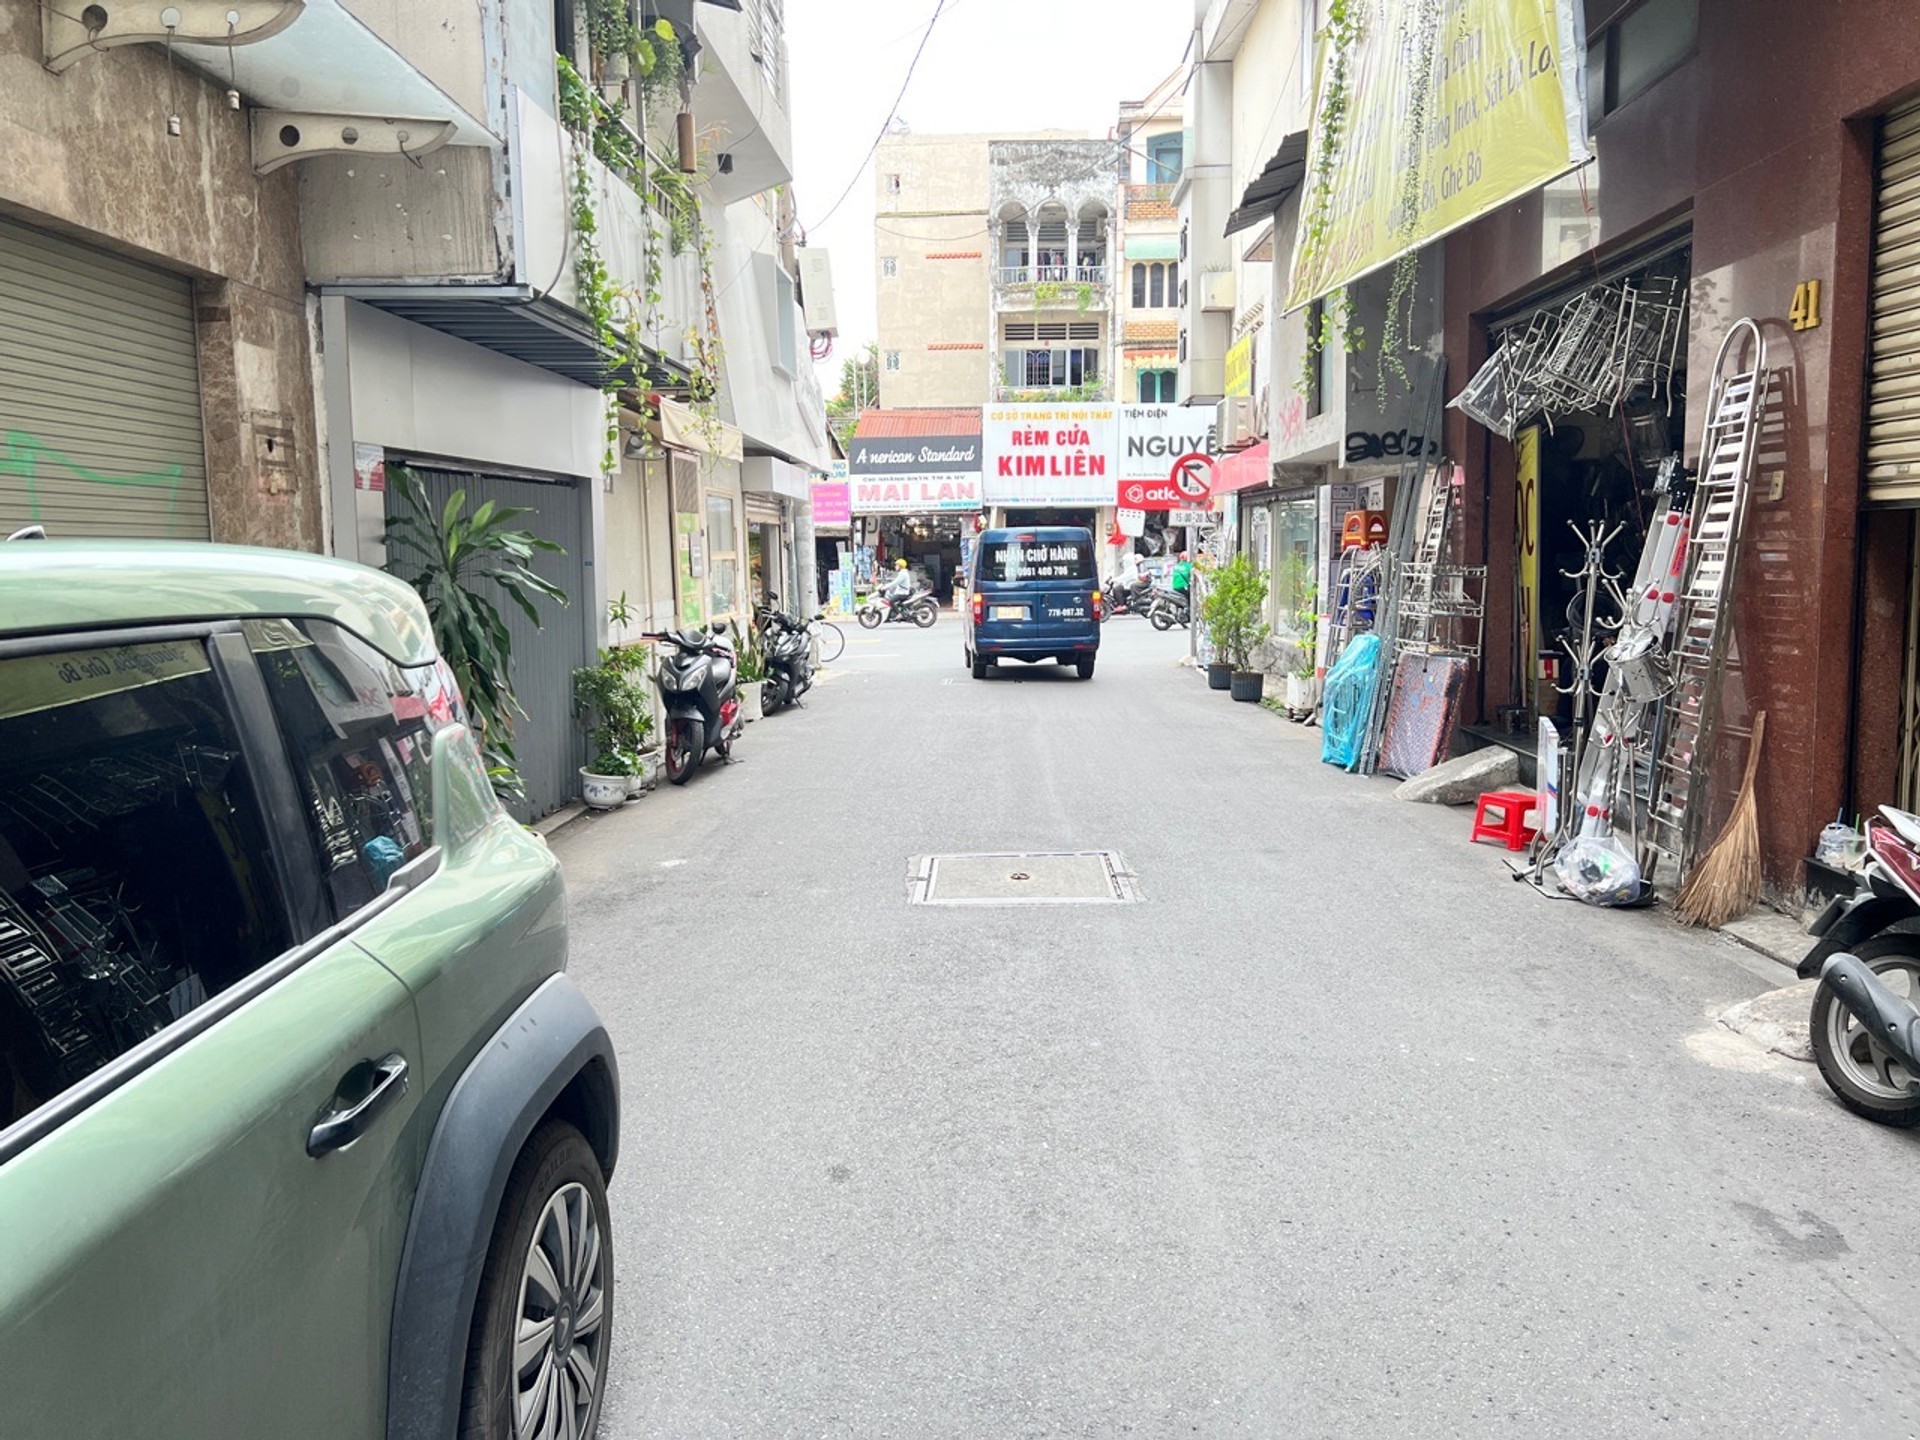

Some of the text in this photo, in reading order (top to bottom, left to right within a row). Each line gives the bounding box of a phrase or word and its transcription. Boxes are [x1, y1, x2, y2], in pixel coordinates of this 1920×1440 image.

[1442, 157, 1464, 200] Ghế
[1467, 137, 1483, 186] Bố
[1788, 278, 1822, 333] 41
[1021, 411, 1053, 421] TRANG
[1124, 408, 1145, 419] TIỆM
[1011, 423, 1090, 446] RÈM CỬA
[917, 445, 976, 464] Standard
[998, 449, 1106, 477] KIM LIÊN
[857, 483, 911, 502] MAI
[920, 482, 976, 501] LAN
[1026, 544, 1048, 563] CHỞ
[1049, 545, 1078, 561] HÀNG
